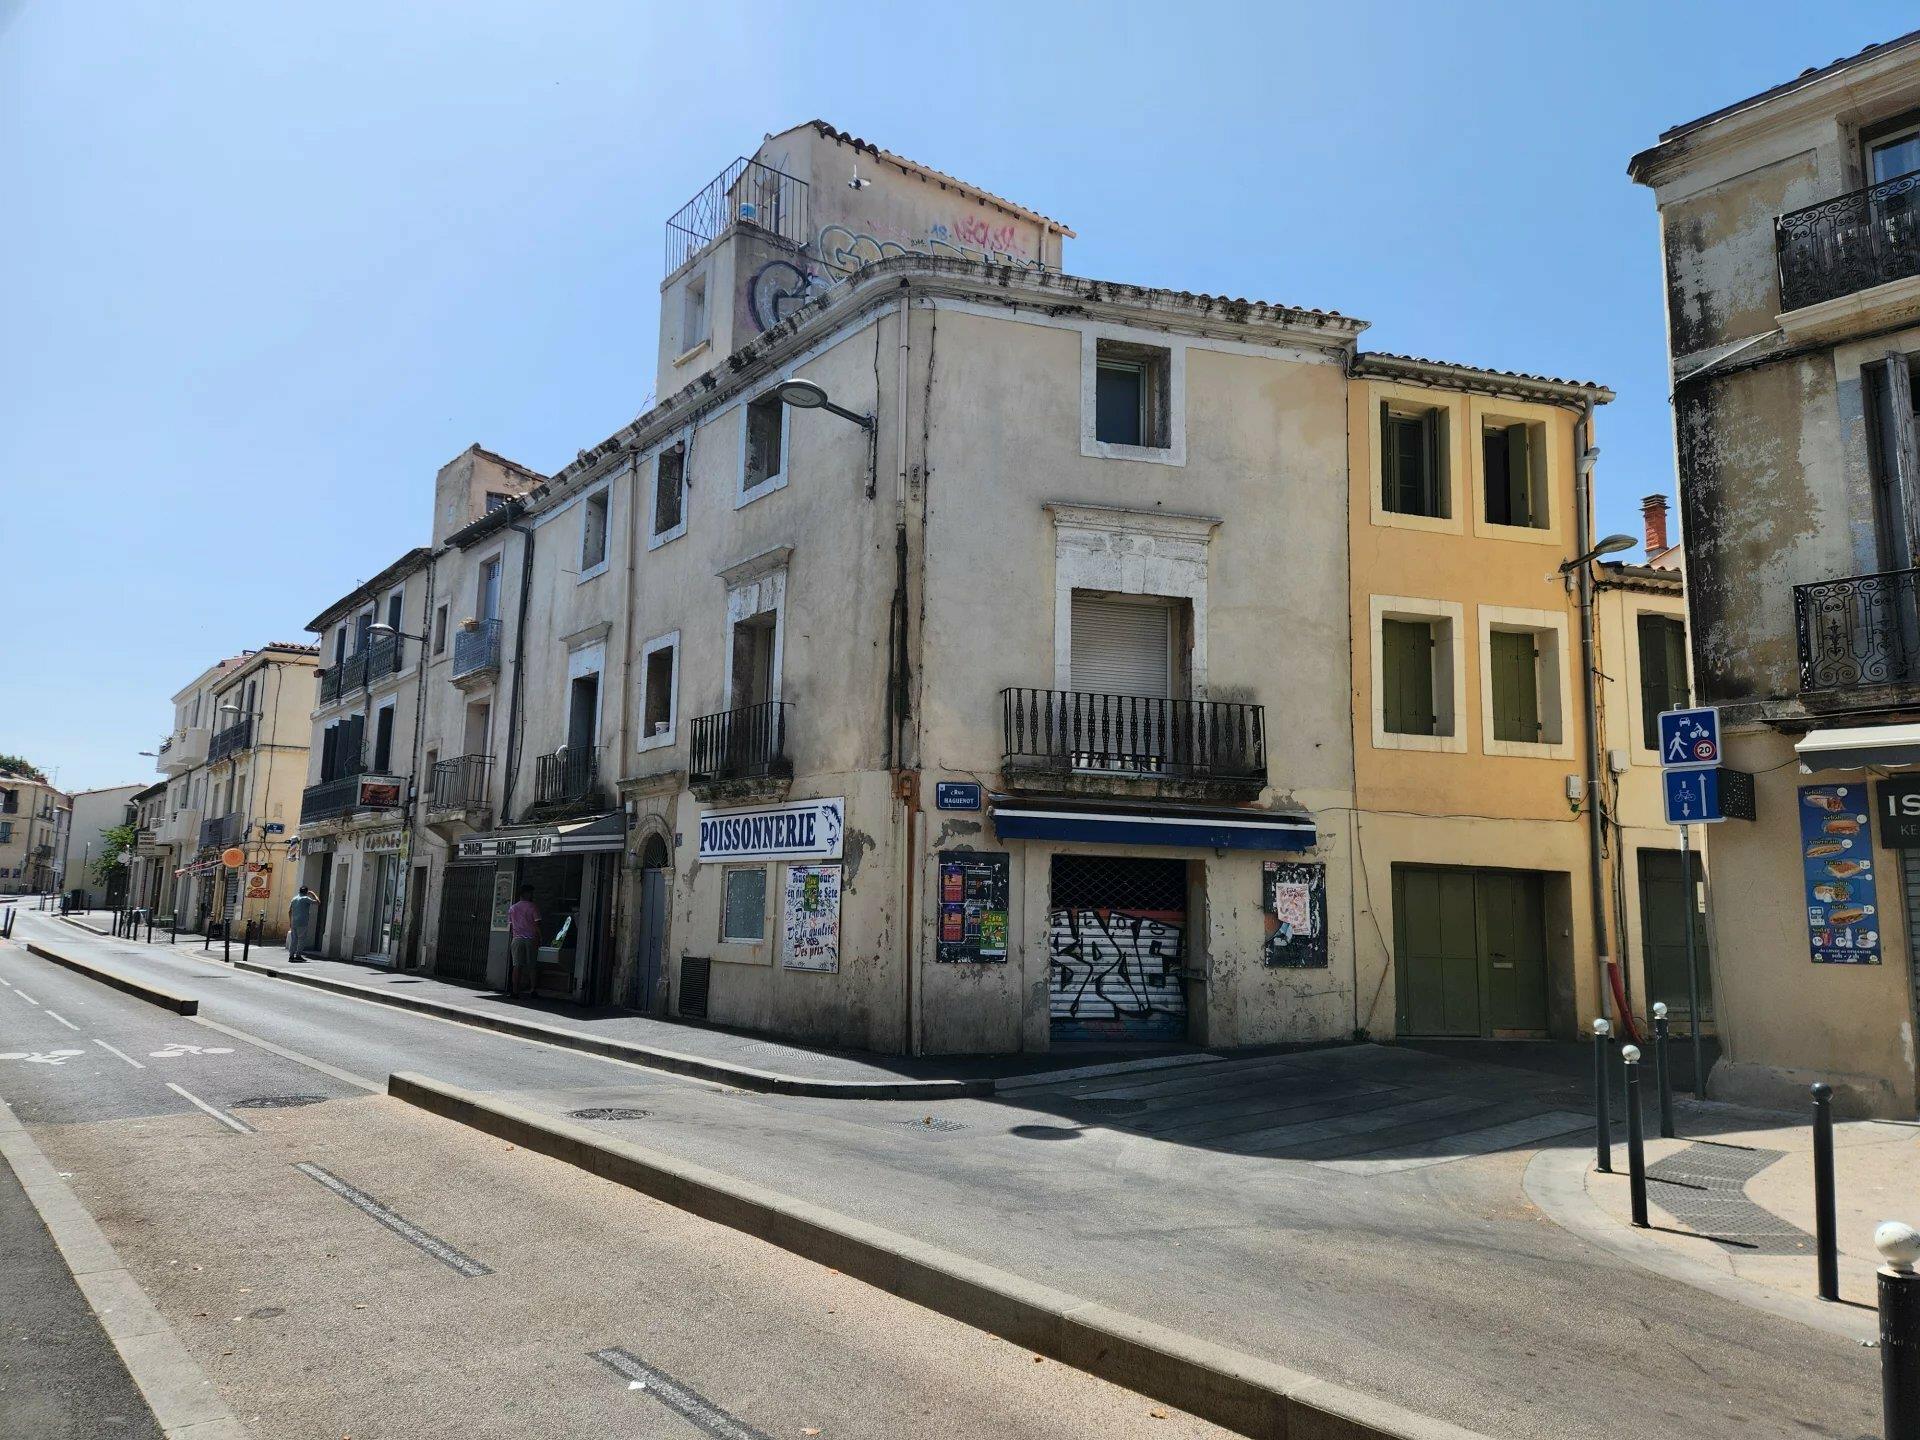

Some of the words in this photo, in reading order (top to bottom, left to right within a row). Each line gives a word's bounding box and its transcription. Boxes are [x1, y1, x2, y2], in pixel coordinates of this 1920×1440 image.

[1699, 746, 1710, 754] 20
[701, 812, 816, 852] POISSONNERIE
[464, 843, 482, 855] SNACK
[531, 838, 551, 853] BABA
[824, 886, 838, 899] Sète
